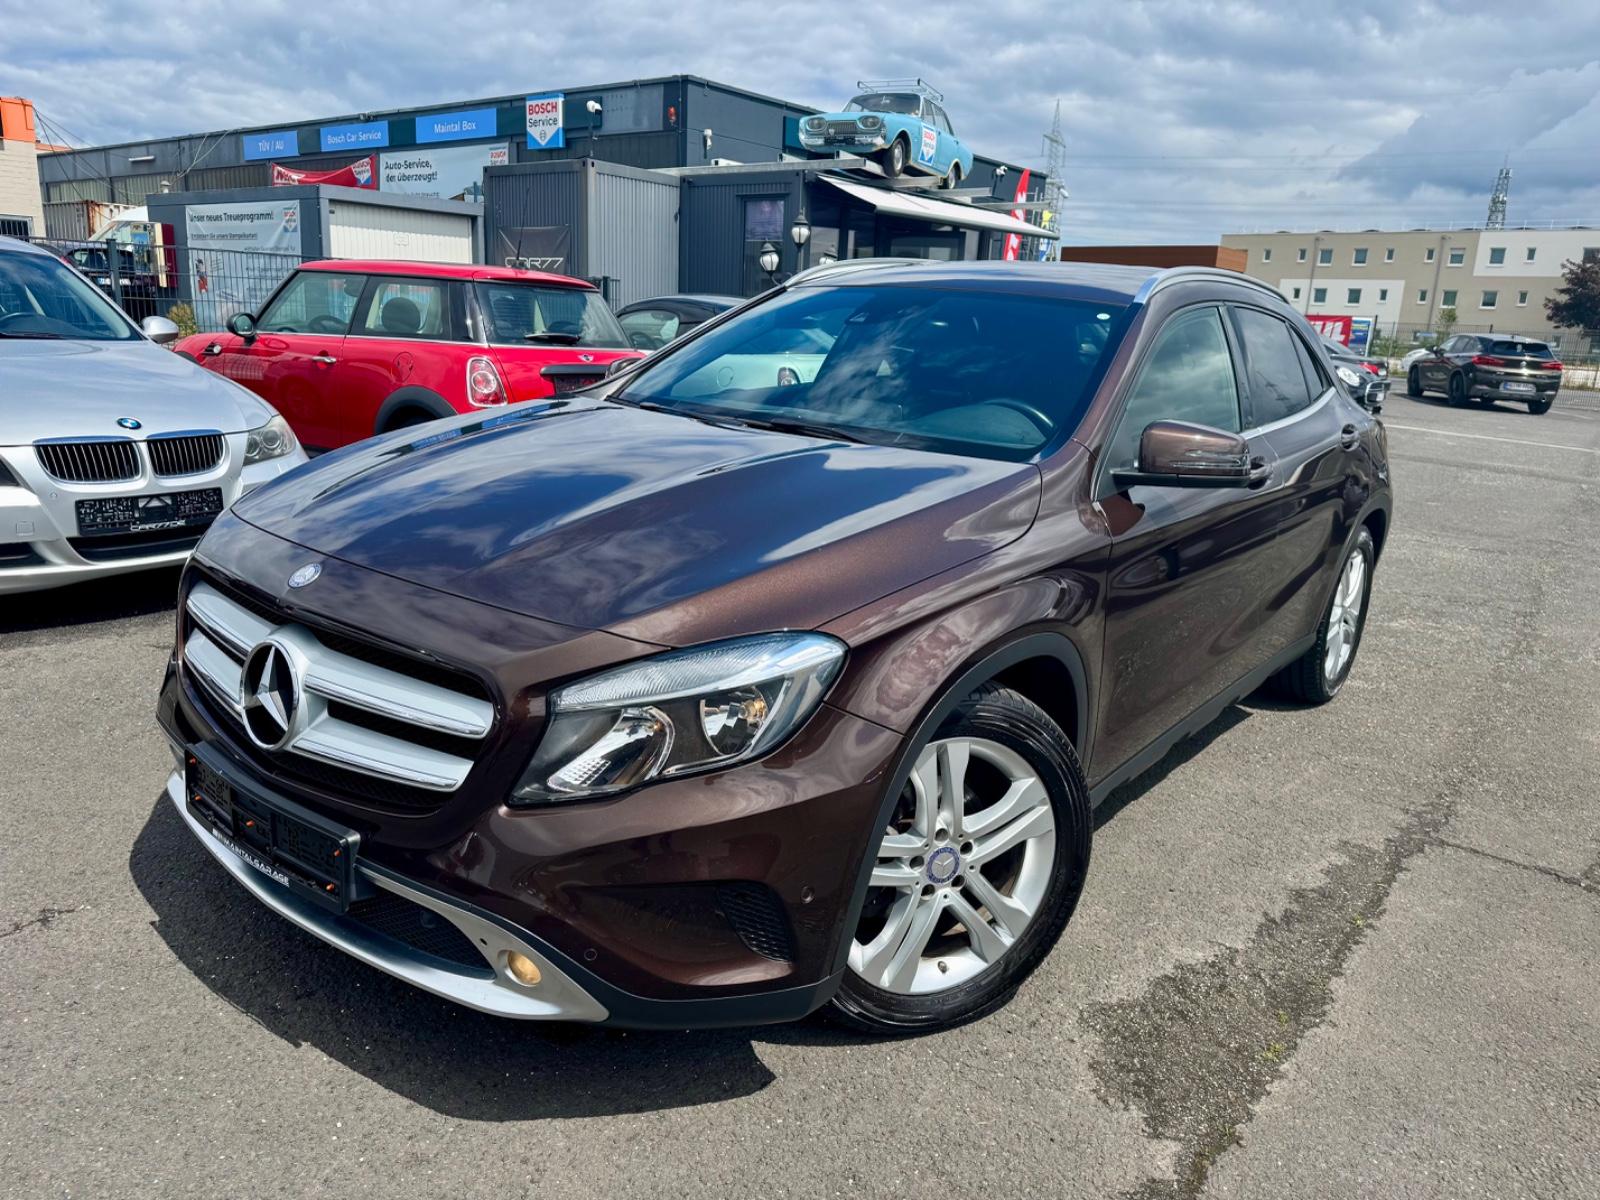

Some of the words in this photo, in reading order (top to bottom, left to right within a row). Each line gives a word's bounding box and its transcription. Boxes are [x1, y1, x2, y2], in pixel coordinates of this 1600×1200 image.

[528, 101, 558, 115] BOSCH
[434, 121, 461, 134] Maintal
[462, 119, 476, 131] Box
[528, 115, 558, 127] Service
[327, 135, 346, 145] Bosch
[346, 132, 357, 143] Car
[358, 130, 382, 142] Service
[258, 140, 270, 152] TÜV
[384, 158, 432, 170] Auto-Service,
[386, 173, 396, 183] der
[397, 171, 438, 183] überzeugt!
